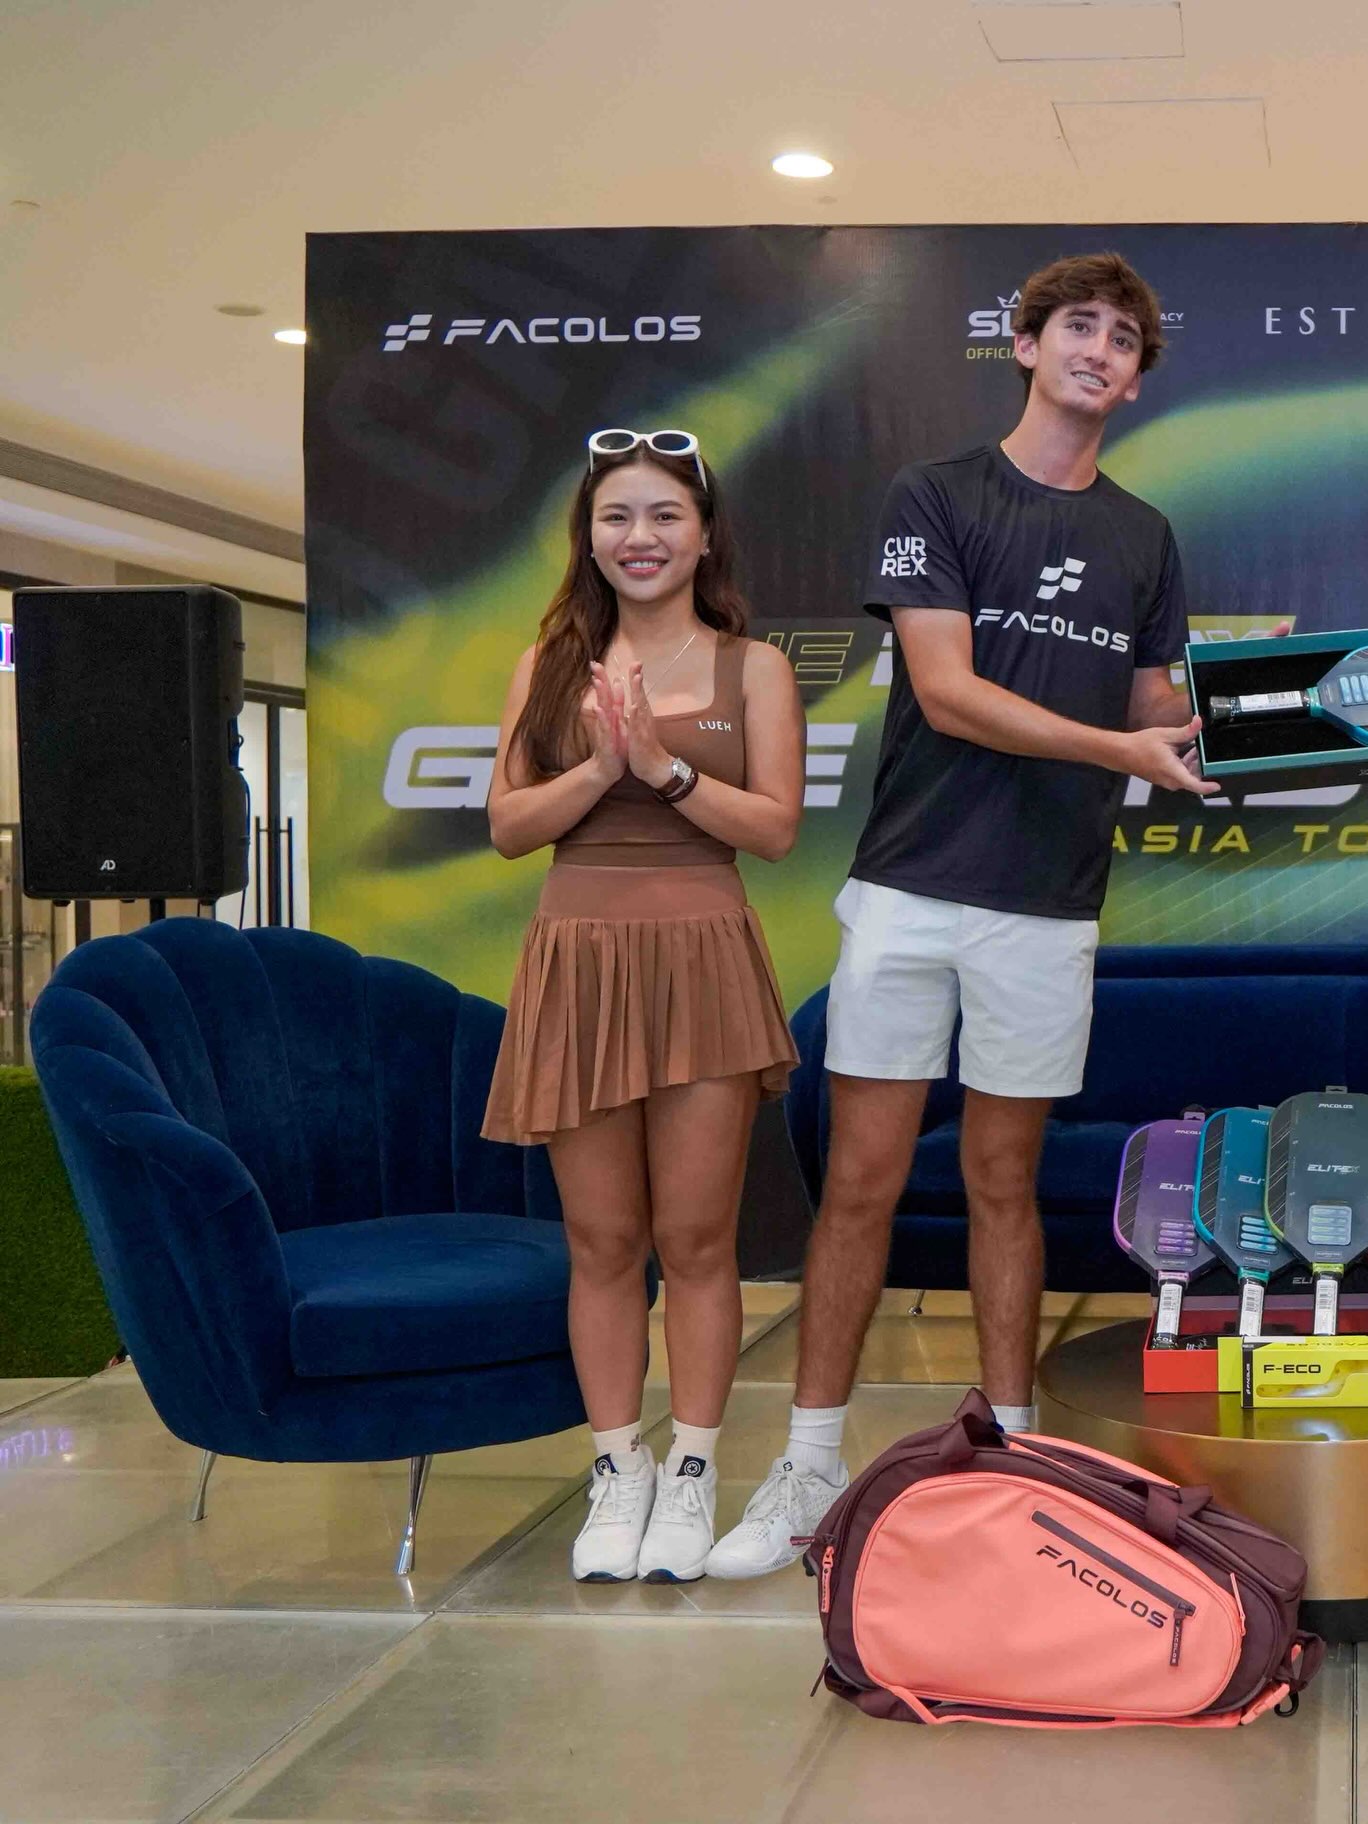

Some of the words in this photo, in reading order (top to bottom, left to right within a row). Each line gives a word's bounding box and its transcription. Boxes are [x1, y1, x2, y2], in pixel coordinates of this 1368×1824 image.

[443, 315, 702, 345] FACOLOS
[883, 536, 927, 558] CUR
[880, 556, 928, 577] REX
[974, 608, 1131, 653] FACOLOS
[698, 720, 732, 732] LUEH
[1263, 1364, 1322, 1374] F-ECO
[1035, 1544, 1168, 1629] FACOLOS
